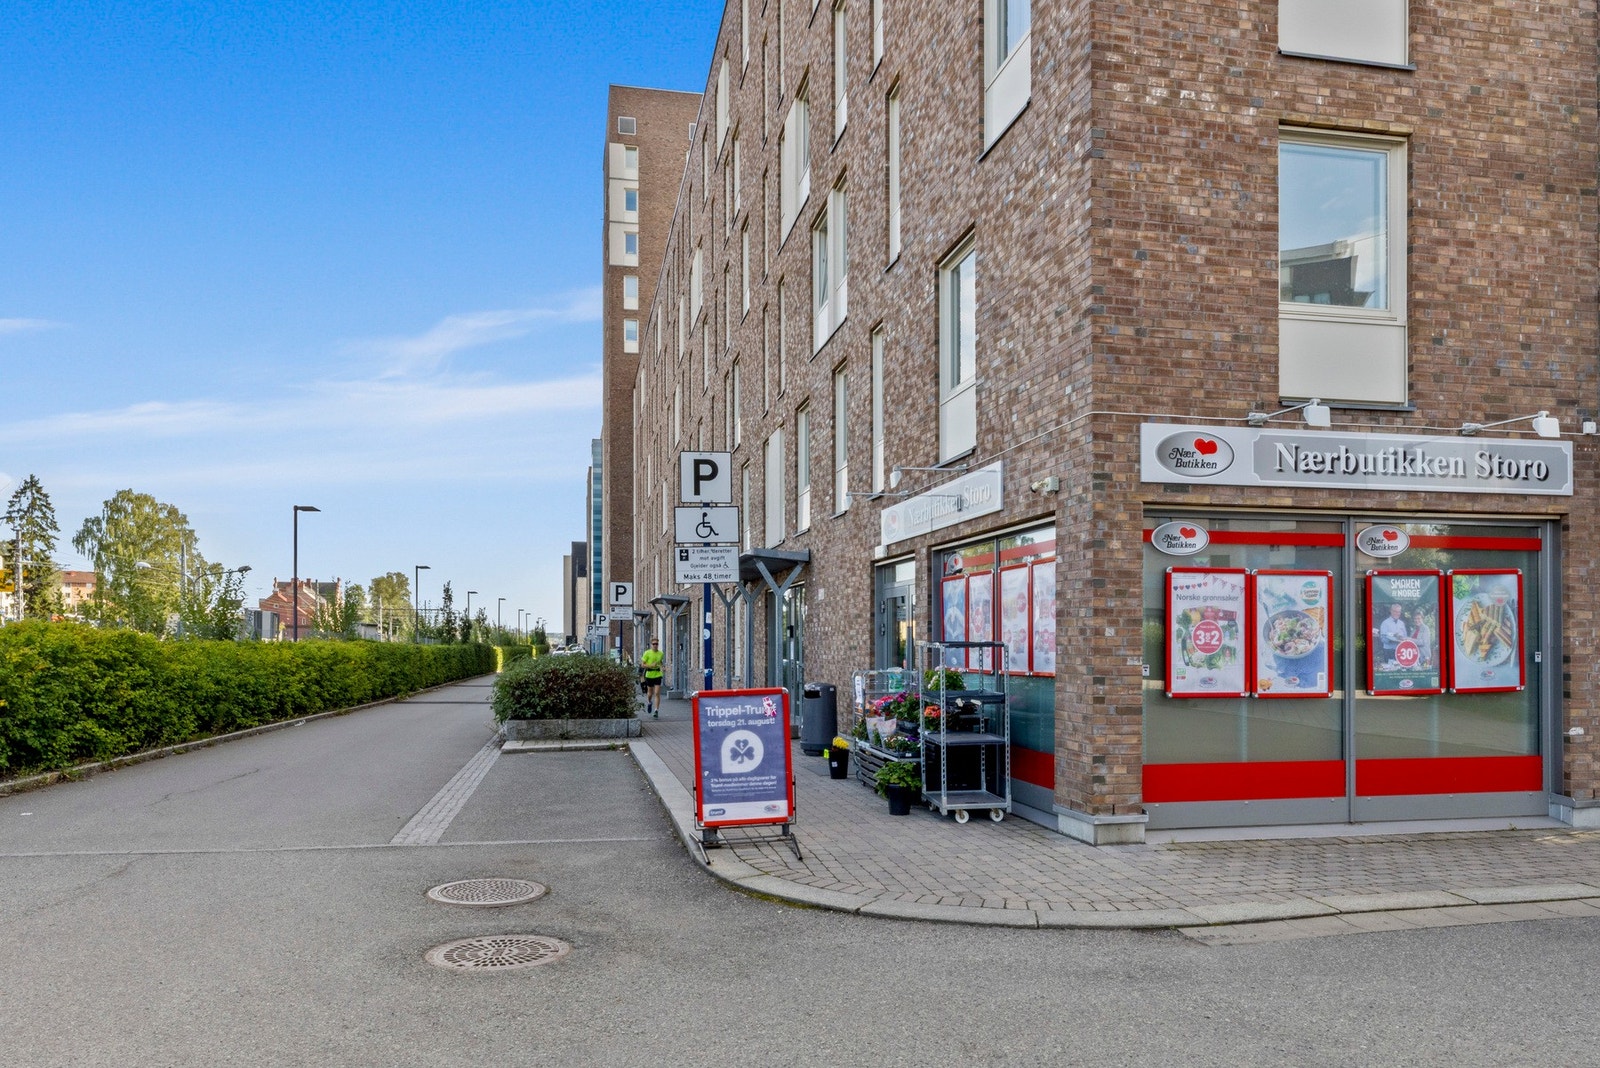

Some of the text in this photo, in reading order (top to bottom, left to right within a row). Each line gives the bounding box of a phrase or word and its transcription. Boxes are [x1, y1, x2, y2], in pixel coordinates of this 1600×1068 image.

[1168, 447, 1197, 459] Nær
[1175, 458, 1217, 469] Butikken
[1273, 442, 1549, 481] Nærbutikken Storo
[693, 459, 719, 496] P
[963, 484, 991, 508] Storo
[1161, 534, 1181, 543] Nær
[1366, 537, 1384, 546] Nær
[1166, 541, 1197, 549] Butikken
[1390, 578, 1420, 589] SMAKEN
[615, 585, 627, 601] P
[1176, 593, 1200, 601] Norske
[1397, 589, 1421, 598] NORGE
[599, 615, 606, 625] P
[1196, 630, 1205, 645] 3
[1210, 630, 1220, 645] 2
[707, 719, 736, 727] torsdag
